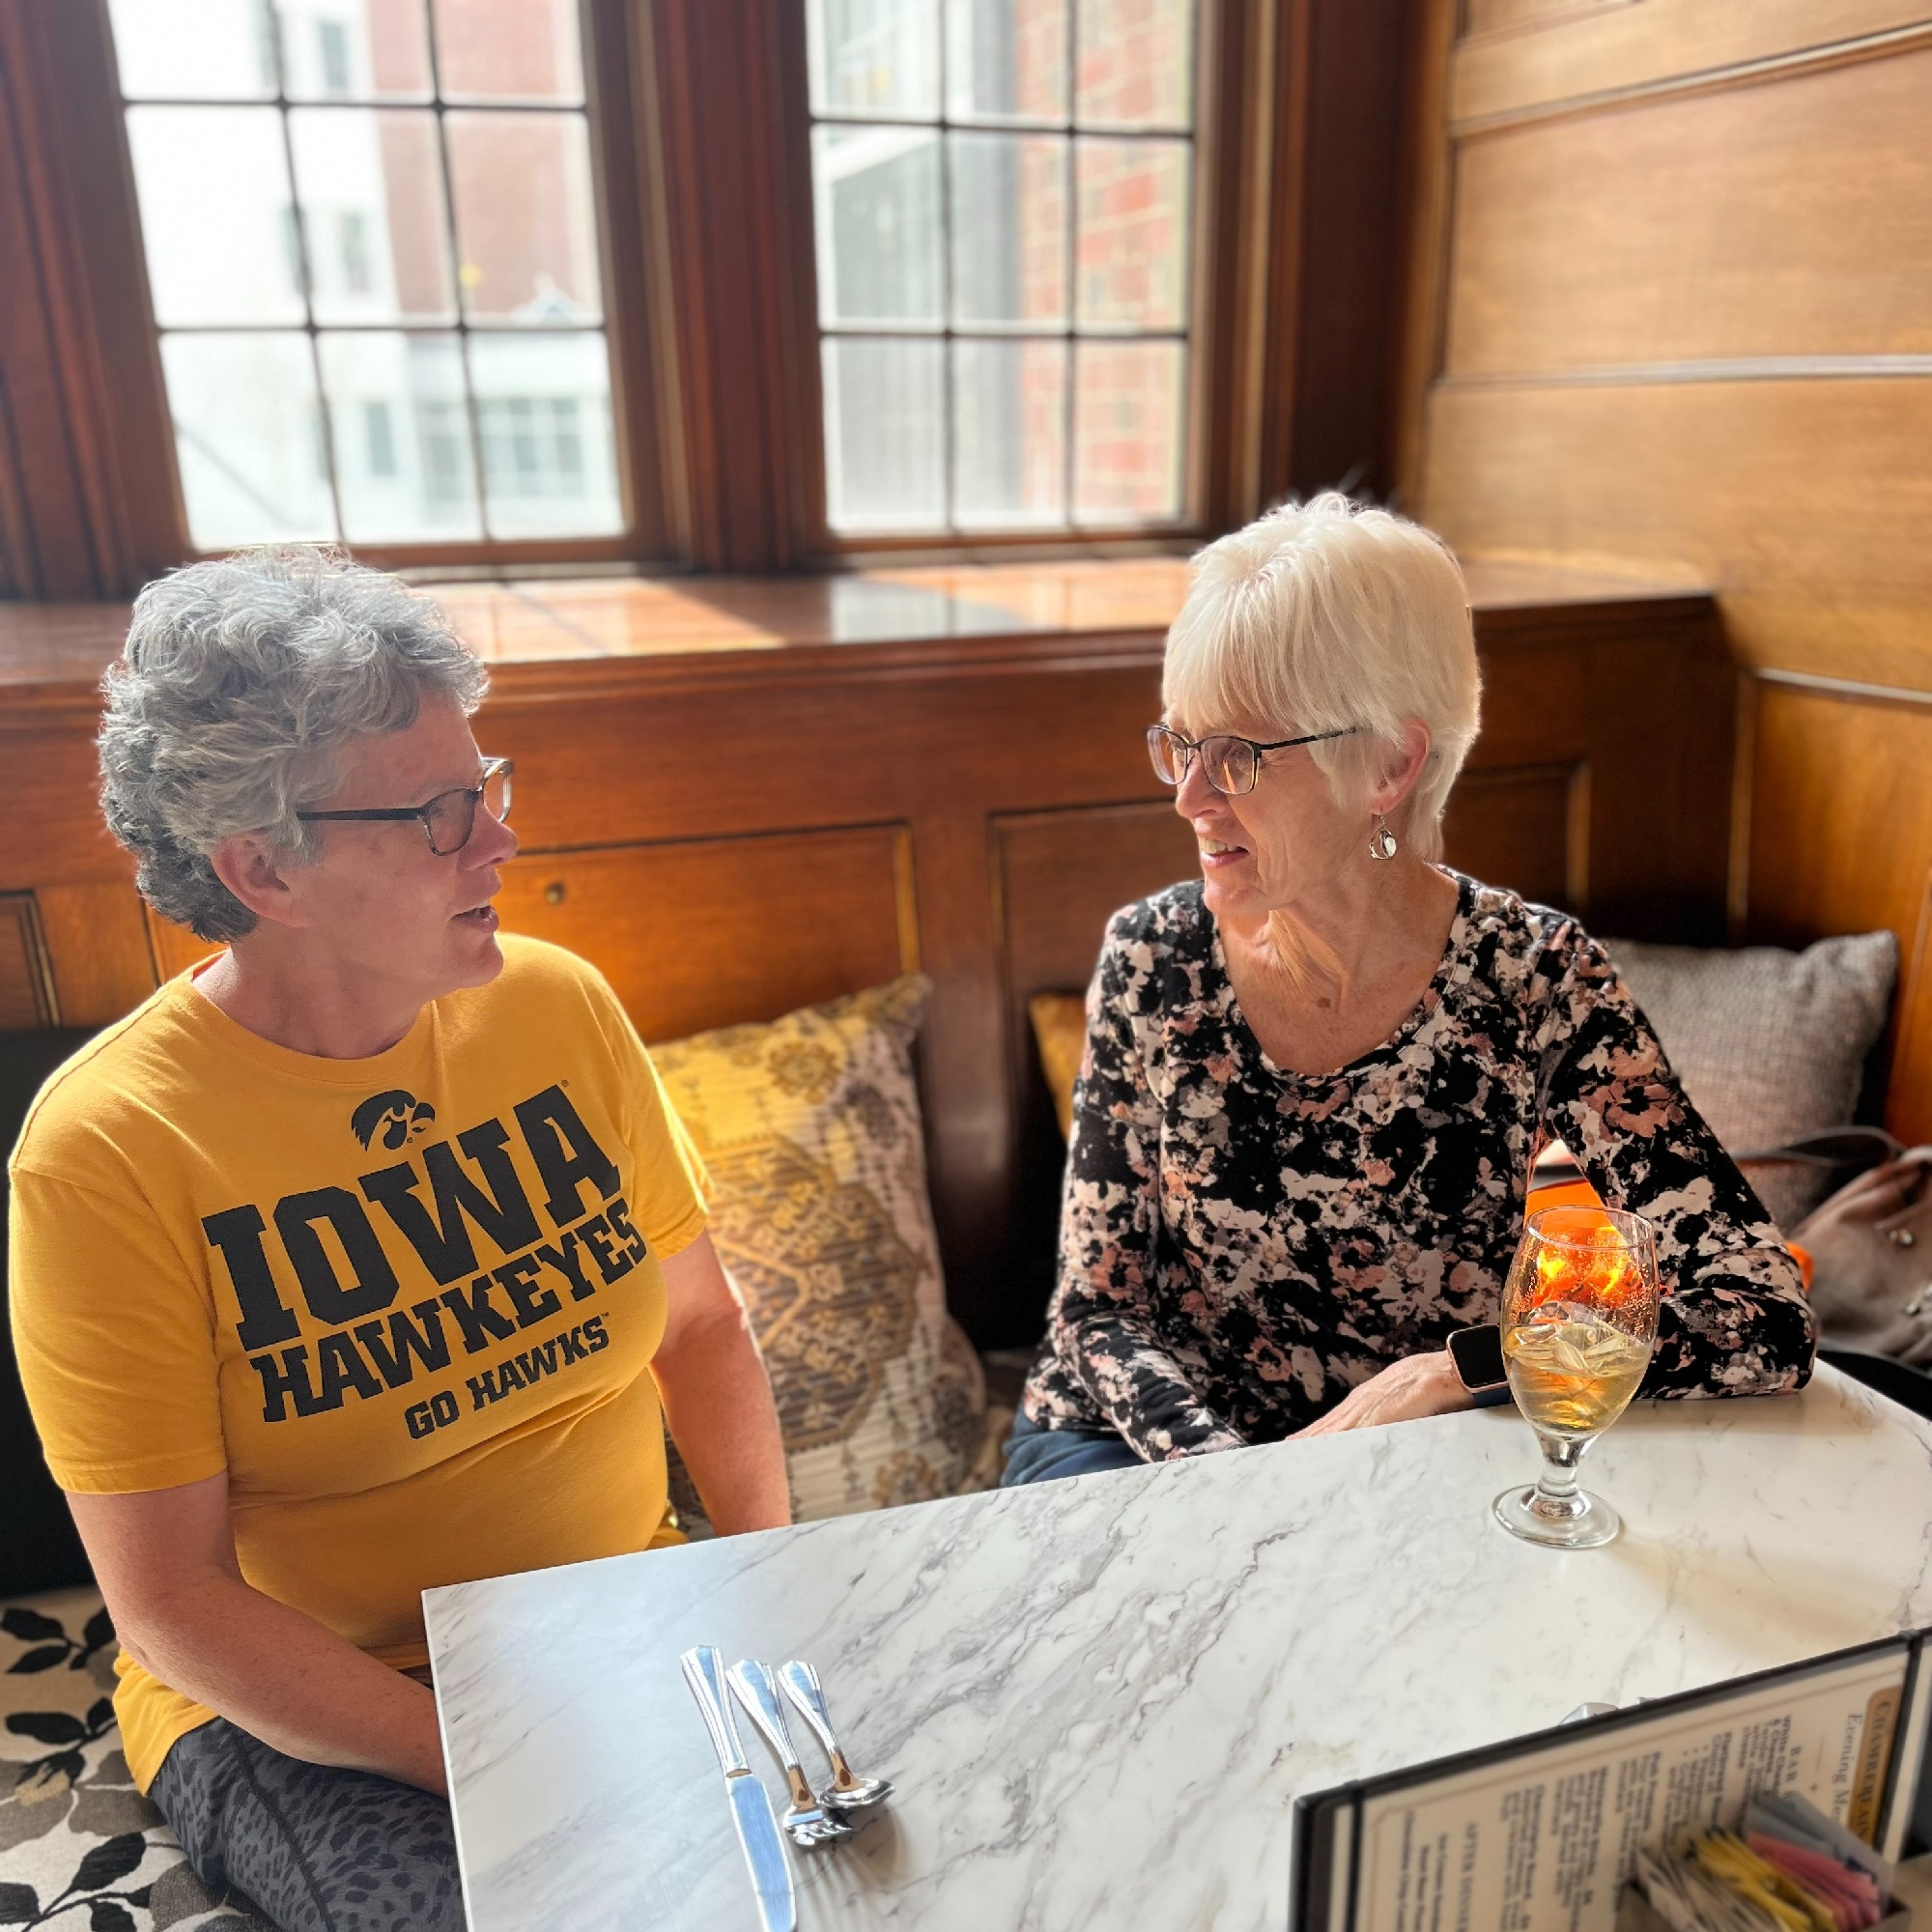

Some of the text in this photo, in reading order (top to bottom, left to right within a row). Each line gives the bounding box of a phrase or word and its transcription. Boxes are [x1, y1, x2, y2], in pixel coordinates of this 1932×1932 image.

[201, 1084, 622, 1351] IOWA
[250, 1197, 647, 1423] HAWKEYES
[405, 1317, 610, 1439] GO HAWKS
[1832, 1714, 1861, 1782] Evening
